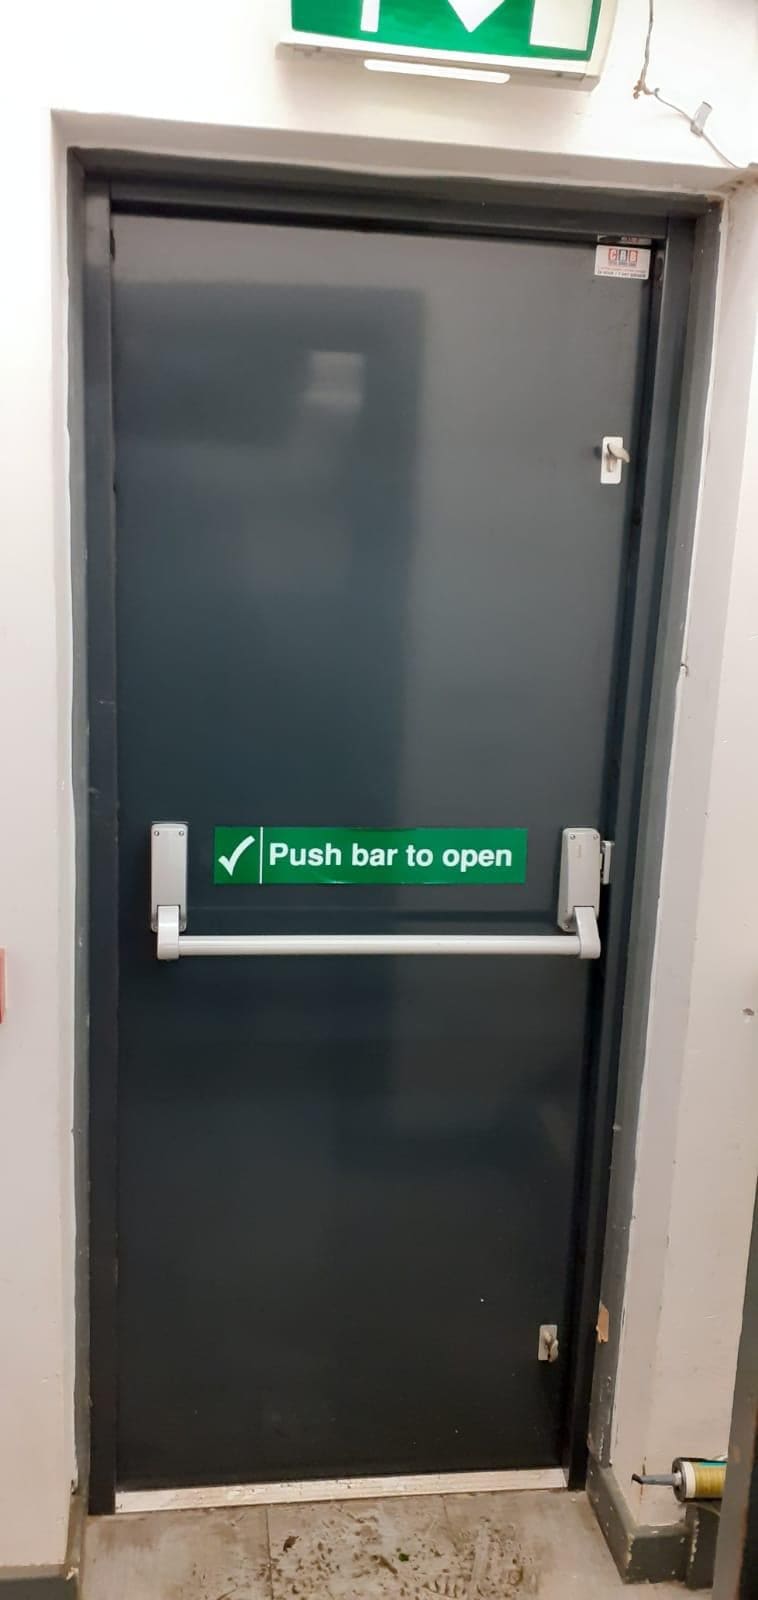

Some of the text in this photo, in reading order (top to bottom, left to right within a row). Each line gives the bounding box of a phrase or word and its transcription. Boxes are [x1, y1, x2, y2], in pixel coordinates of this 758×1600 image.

[269, 843, 512, 873] Push bar to open
